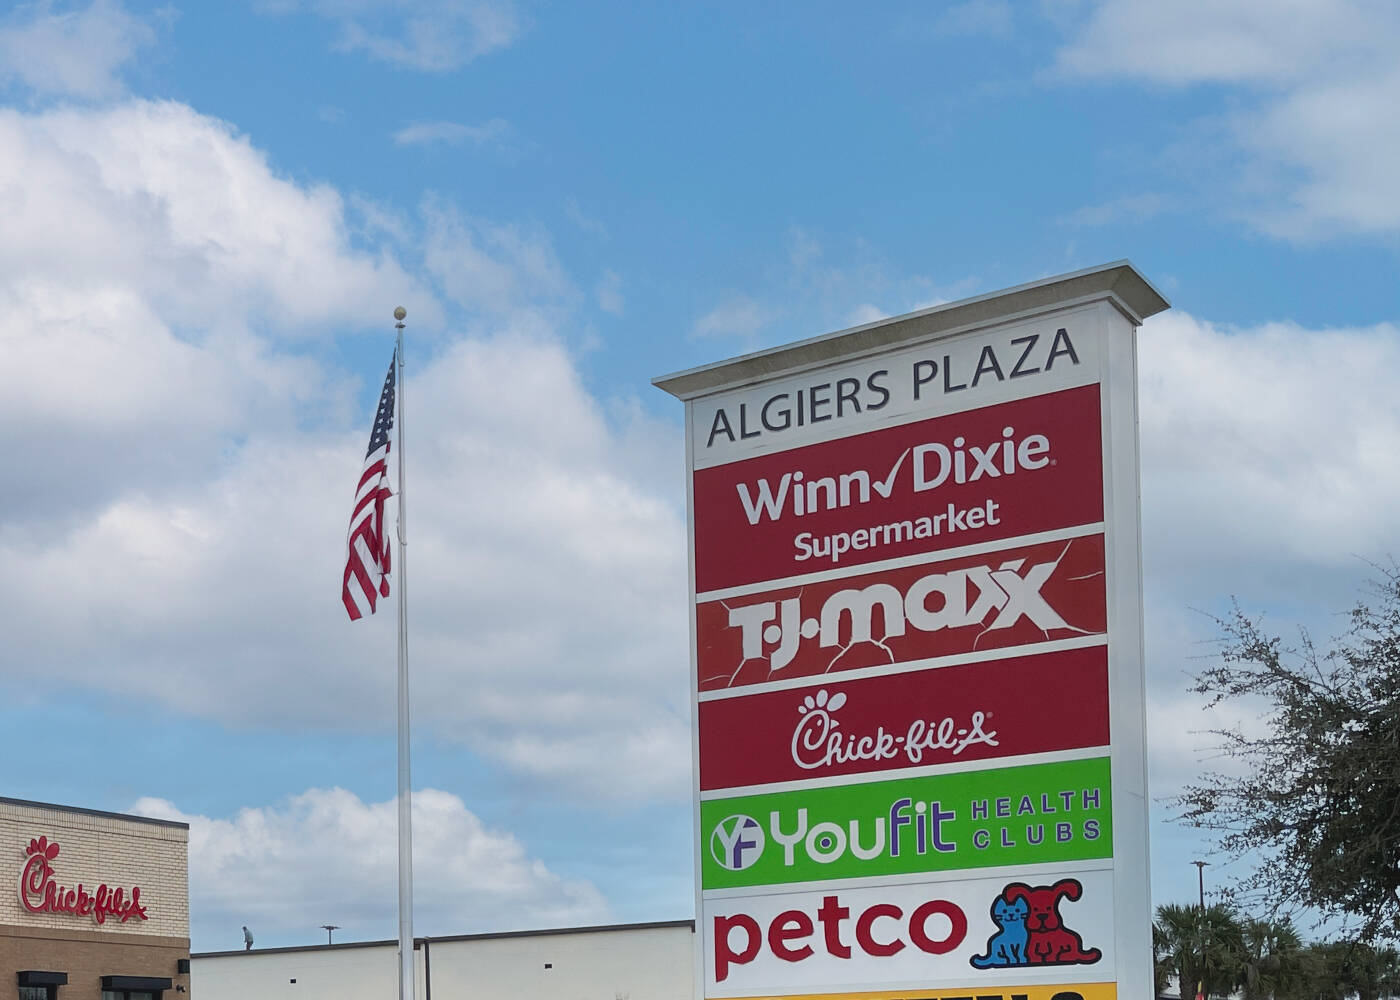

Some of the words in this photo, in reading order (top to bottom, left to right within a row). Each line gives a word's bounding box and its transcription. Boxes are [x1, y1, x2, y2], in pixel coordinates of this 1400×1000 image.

[706, 370, 890, 448] ALGIERS
[913, 328, 1080, 400] PLAZA
[736, 468, 871, 525] Winn
[913, 426, 1051, 493] Dixie
[794, 500, 1001, 563] Supermarket
[791, 707, 1000, 770] Chick-fil-A
[971, 788, 1101, 820] HEALTH
[973, 819, 1101, 850] CLUBS
[20, 852, 149, 925] Chick-fil-A
[714, 896, 968, 982] petco
